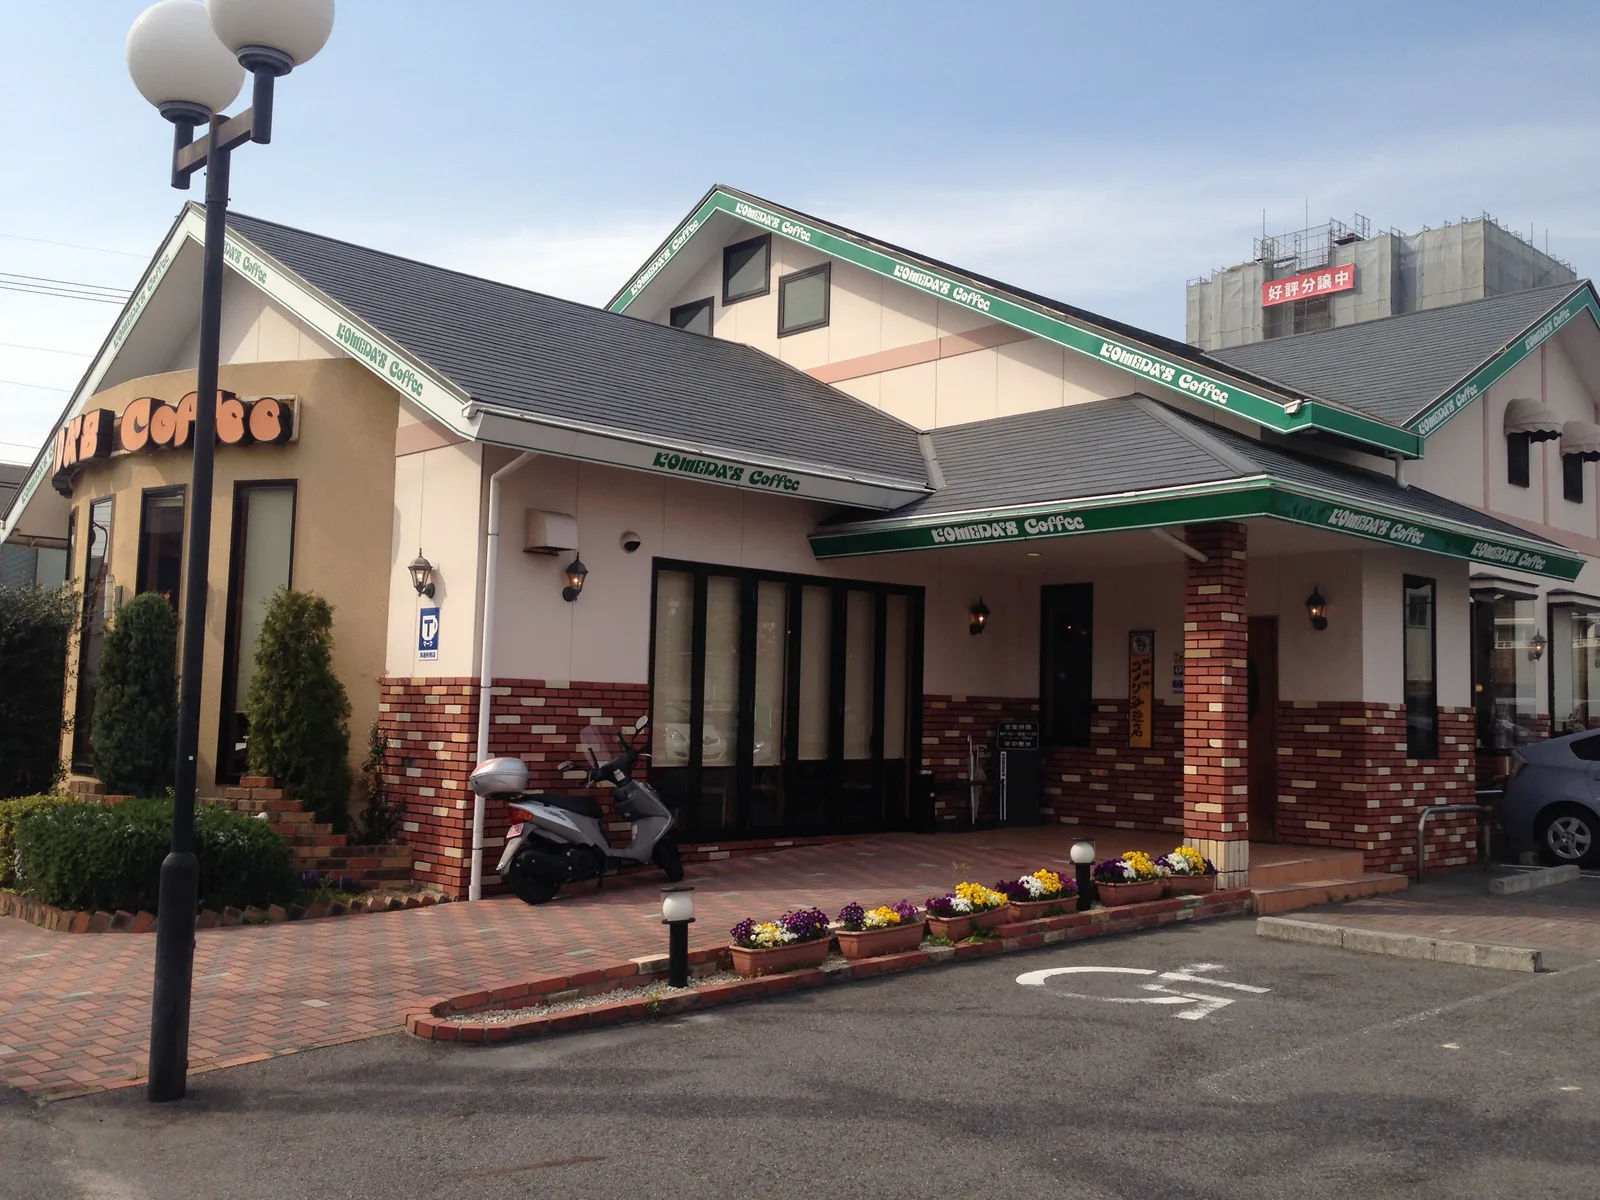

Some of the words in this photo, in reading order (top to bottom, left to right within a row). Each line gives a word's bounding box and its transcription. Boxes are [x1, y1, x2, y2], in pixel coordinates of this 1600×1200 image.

[735, 202, 781, 229] KOMEDA'S
[781, 221, 811, 242] Coffee
[242, 256, 267, 284] Coffee
[630, 248, 671, 295] KOMEDA'S
[672, 219, 699, 250] Coffee
[893, 264, 951, 295] KOMEDA'S
[952, 286, 991, 312] Coffee
[336, 322, 388, 370] KOMEDA'S
[389, 360, 424, 397] Coffee
[1099, 342, 1176, 382] KOMEDA'S
[1178, 373, 1229, 404] Coffee
[120, 389, 282, 452] Cofee
[1418, 399, 1455, 435] KOMEDA'S
[1455, 384, 1478, 407] Coffee
[652, 451, 745, 481] KOMEDA'S
[748, 470, 800, 492] Coffee
[931, 520, 1019, 543] KOMEDA'S
[1024, 515, 1085, 534] Coffee
[1327, 508, 1391, 536] KOMEDA'S
[1389, 523, 1425, 545] Coffee
[1470, 542, 1520, 564] KOMEDA'S
[1518, 552, 1547, 570] Coffee
